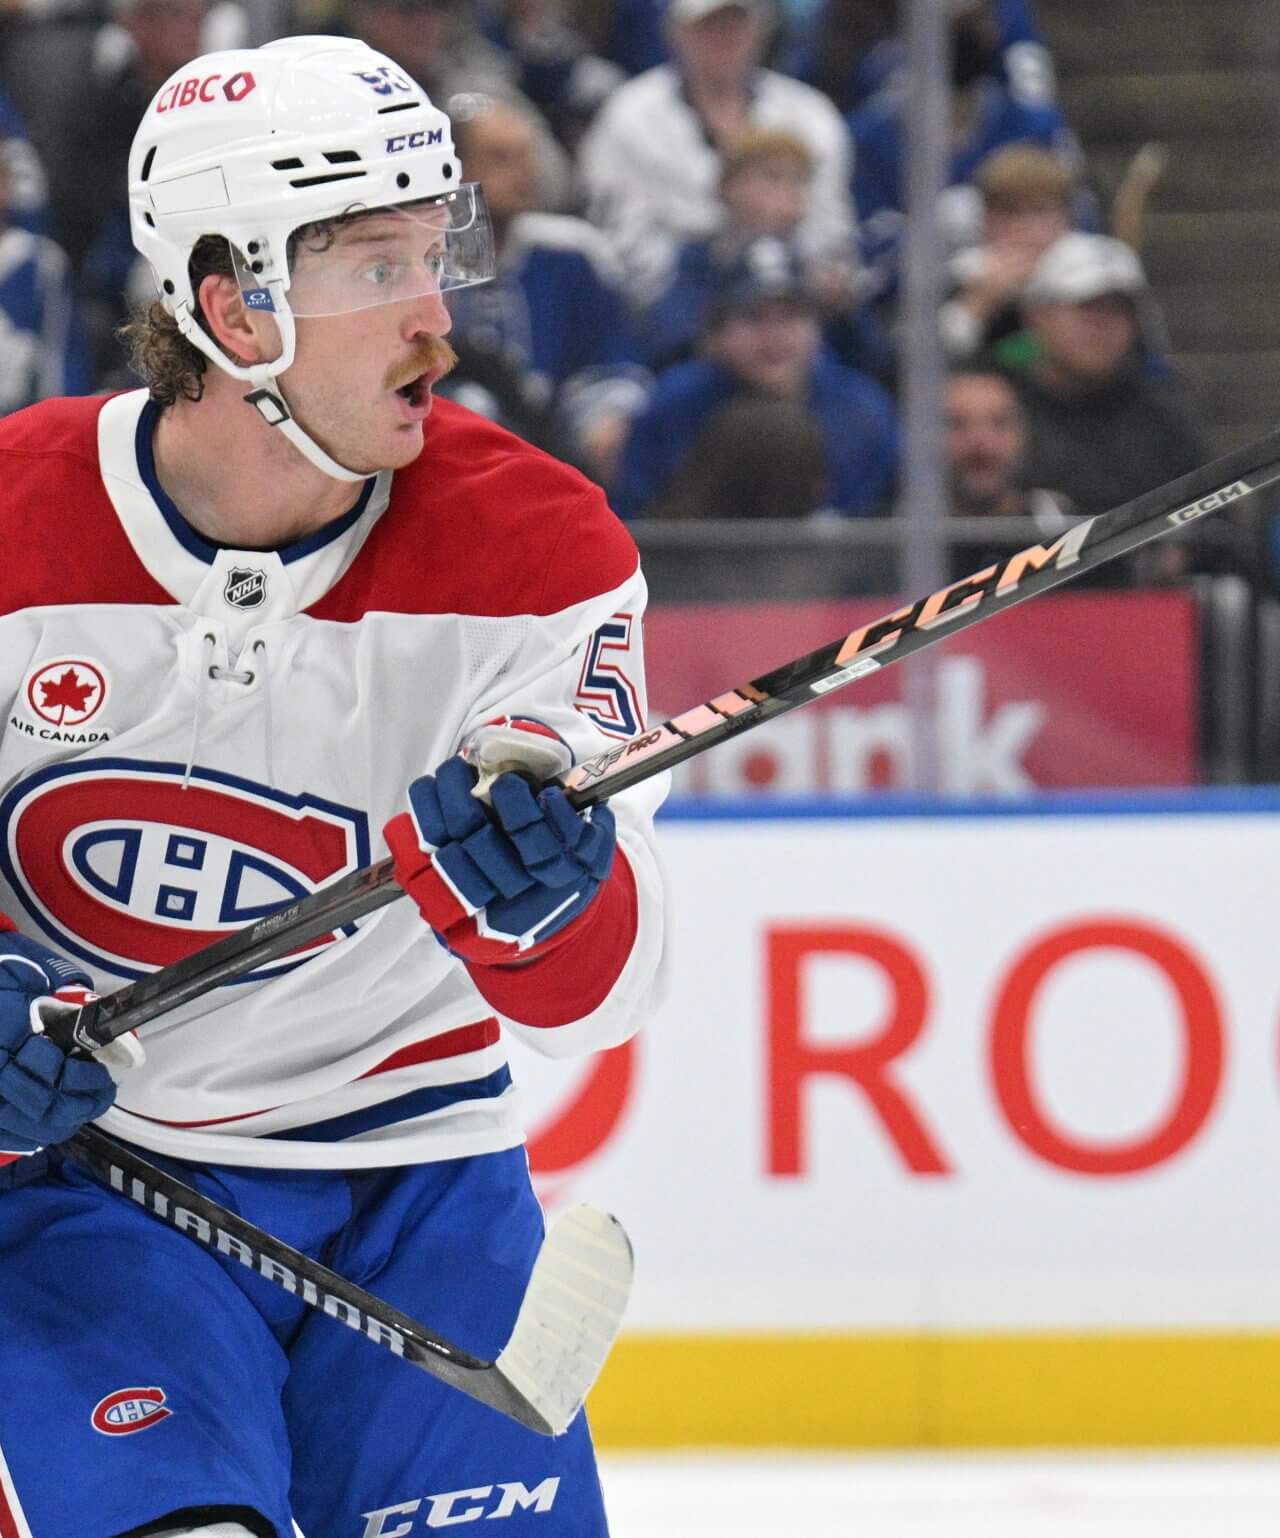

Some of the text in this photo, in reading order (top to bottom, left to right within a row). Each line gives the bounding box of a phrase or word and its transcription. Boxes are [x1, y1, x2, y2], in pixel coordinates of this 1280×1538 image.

[156, 74, 224, 114] CIBC
[384, 127, 443, 153] CCM
[1175, 483, 1245, 522] CCM
[232, 578, 260, 601] NHL
[833, 516, 1096, 668] CCM
[10, 717, 111, 744] AIR CANADA
[627, 730, 662, 757] PRO
[361, 1476, 562, 1538] CCM
